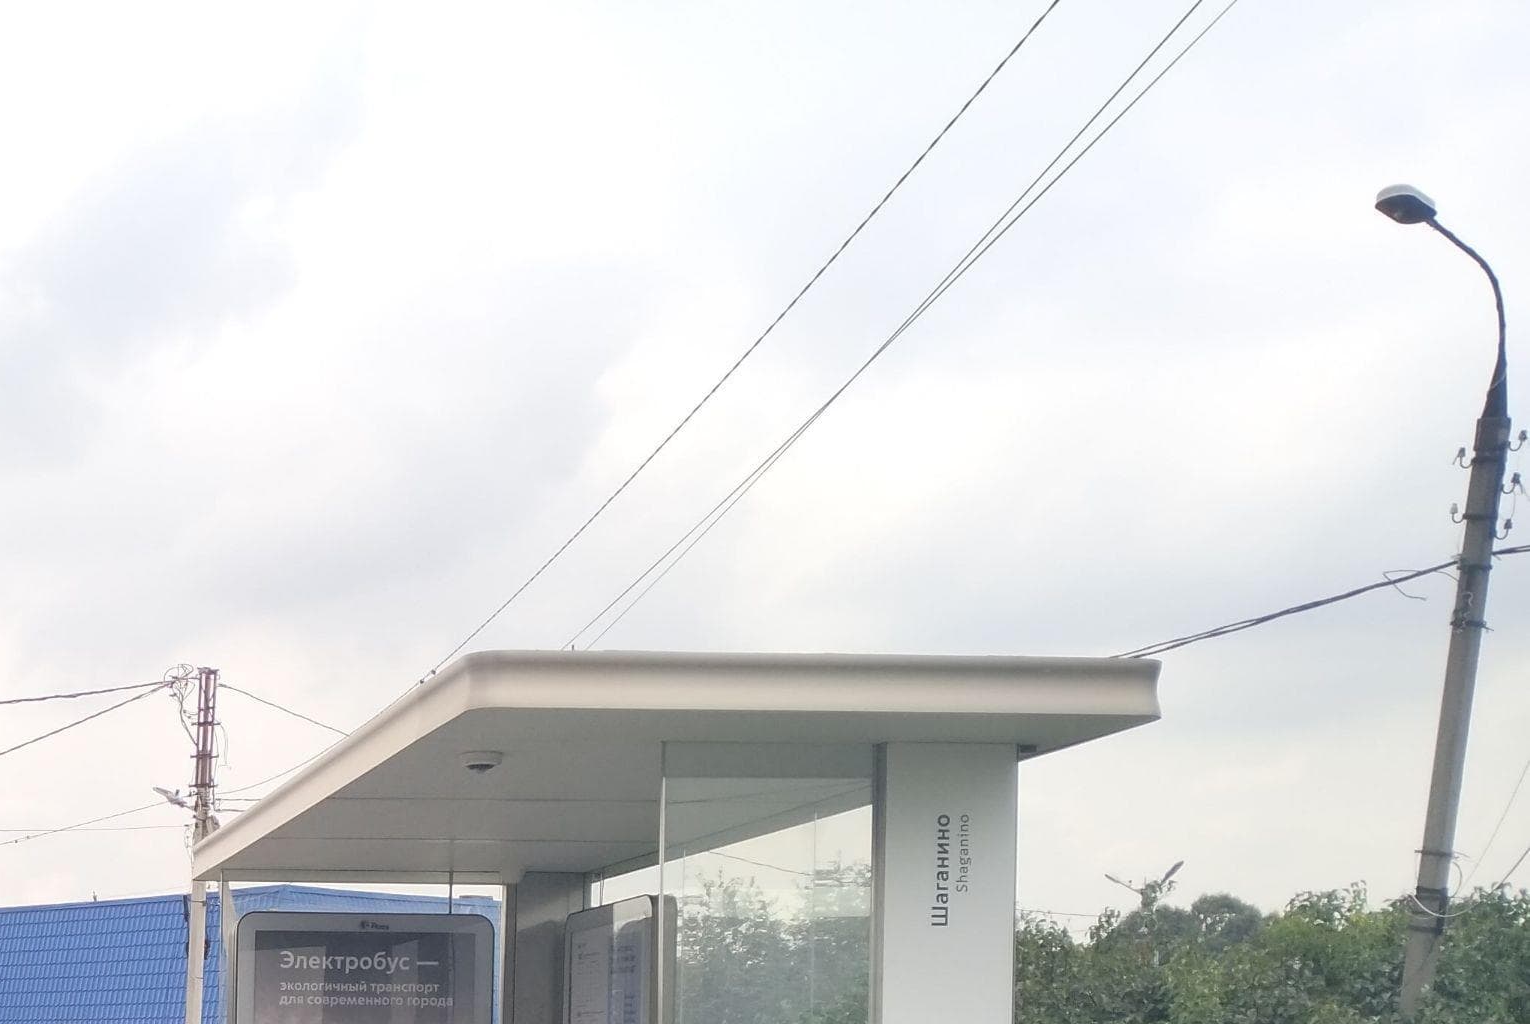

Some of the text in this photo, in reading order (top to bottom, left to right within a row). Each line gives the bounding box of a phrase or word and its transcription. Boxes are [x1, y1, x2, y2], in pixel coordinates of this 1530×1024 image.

[956, 814, 971, 892] Shaganino
[931, 814, 950, 926] Шаганино
[279, 950, 410, 974] Электробус
[279, 981, 439, 993] экологичный транспорт
[279, 996, 453, 1008] для современного города
